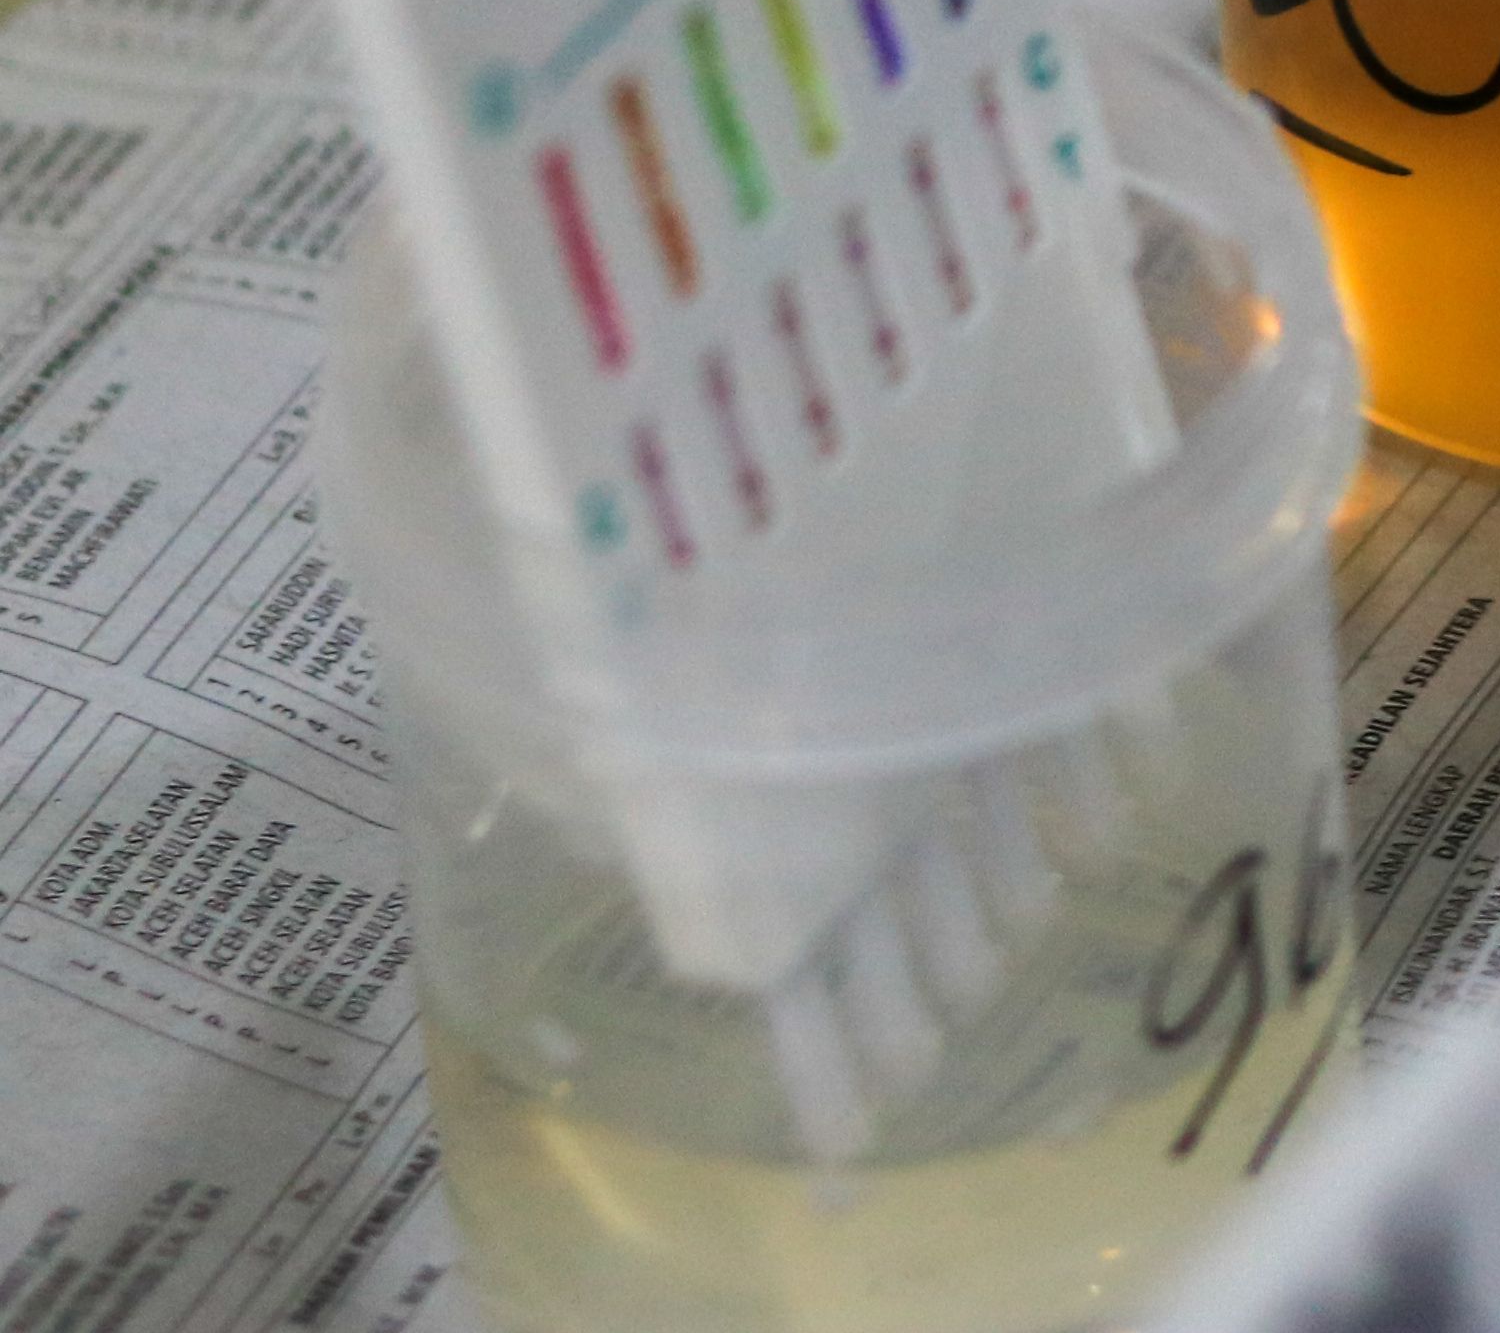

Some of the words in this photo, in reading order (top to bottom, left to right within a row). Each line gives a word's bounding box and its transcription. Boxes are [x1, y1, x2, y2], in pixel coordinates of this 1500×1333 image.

[238, 557, 327, 651] SAFARUDDIN
[269, 620, 317, 665] HADI
[302, 615, 367, 679] HASNITA
[1338, 691, 1414, 784] EADILAN
[1404, 595, 1493, 685] SEJAHTERA
[36, 859, 83, 903] KOTA
[70, 816, 119, 861] ADM.
[69, 846, 136, 915] JAKARTA
[126, 779, 193, 846] SELATAN
[103, 887, 147, 929] KOTA
[136, 764, 246, 885] SUBULUSSALAM
[1362, 839, 1418, 894] NAMA
[1399, 765, 1468, 836] LENGKAP
[1433, 789, 1498, 858] DAERAH
[136, 898, 182, 944] ACEH
[172, 830, 239, 898] SELATAN
[169, 913, 216, 958] ACEH
[206, 860, 258, 911] BARAT
[248, 812, 297, 860] DAYA
[202, 927, 251, 974] ACEH
[240, 866, 301, 926] SINGKIL
[236, 941, 283, 987] ACEH
[274, 874, 340, 940] SELATAN
[269, 955, 316, 1000] ACEH
[305, 887, 372, 955] SELATAN
[303, 967, 349, 1012] KOTA
[336, 980, 381, 1025] KOTA
